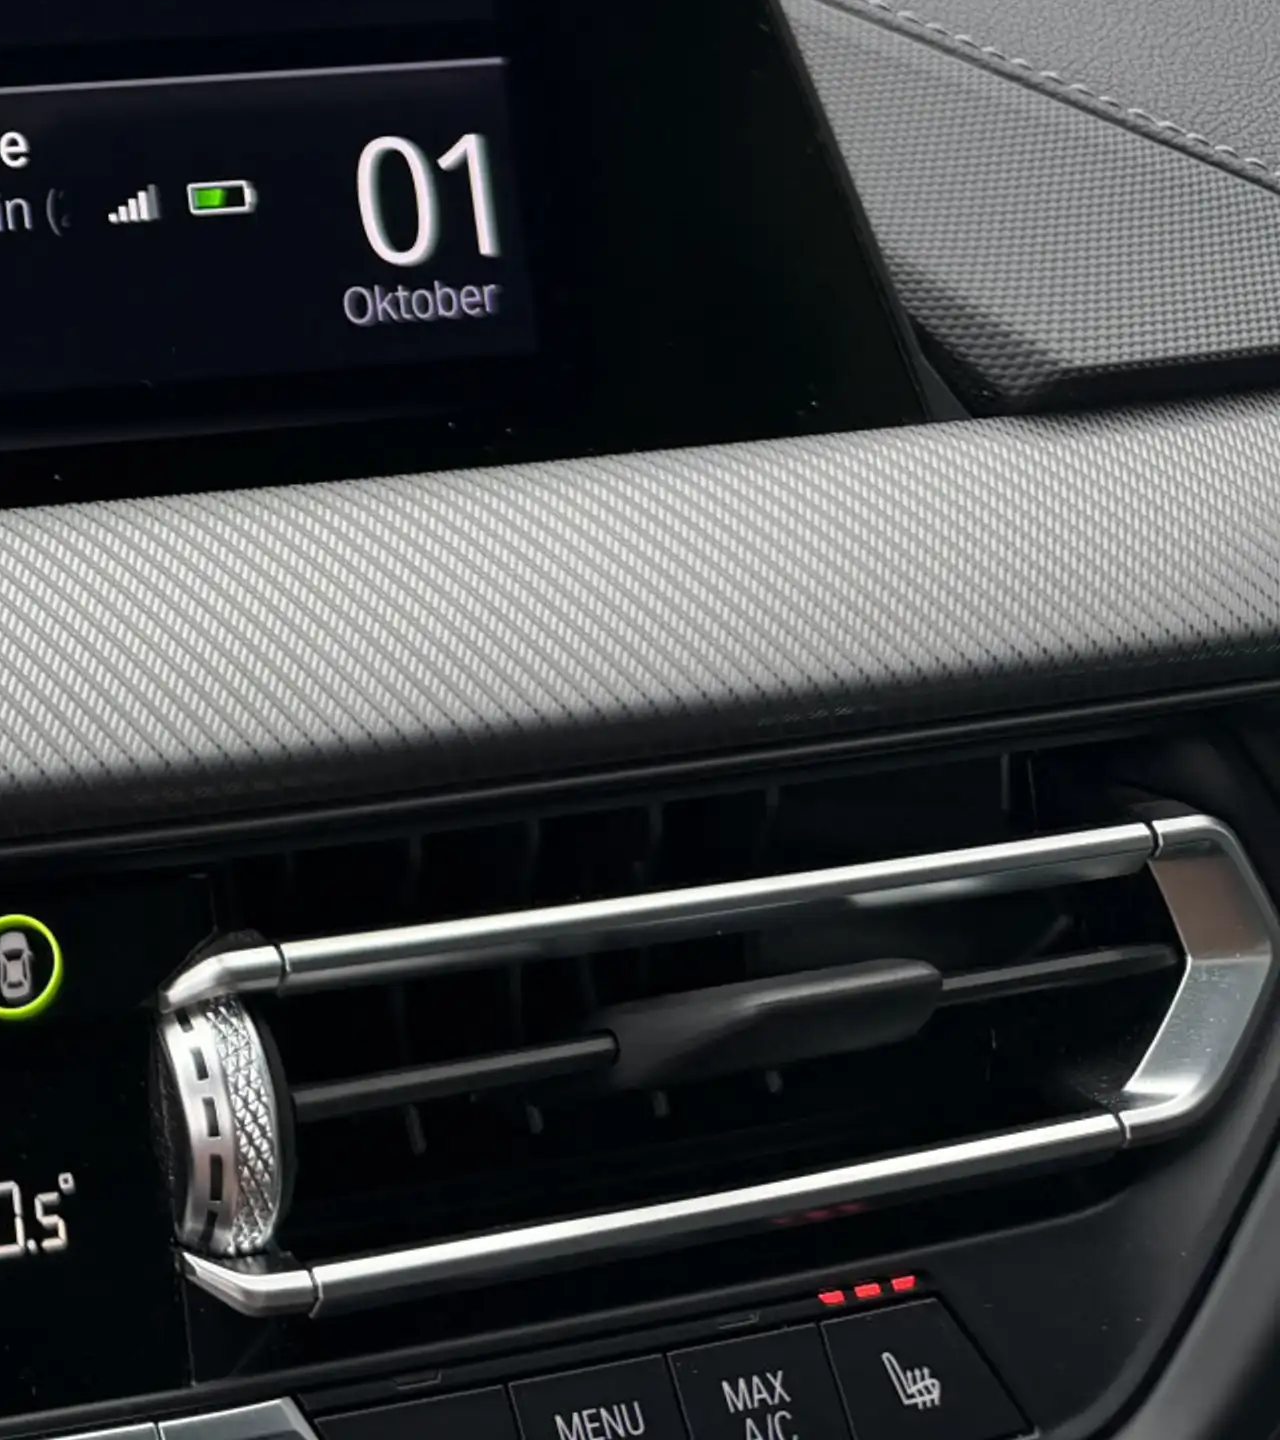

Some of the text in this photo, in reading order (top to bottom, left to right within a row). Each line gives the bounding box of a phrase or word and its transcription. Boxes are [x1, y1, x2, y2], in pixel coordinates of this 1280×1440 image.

[357, 131, 503, 268] 01
[342, 277, 498, 326] Oktober
[722, 1370, 792, 1414] MAX
[554, 1401, 646, 1440] MENU
[744, 1410, 800, 1440] A/C
